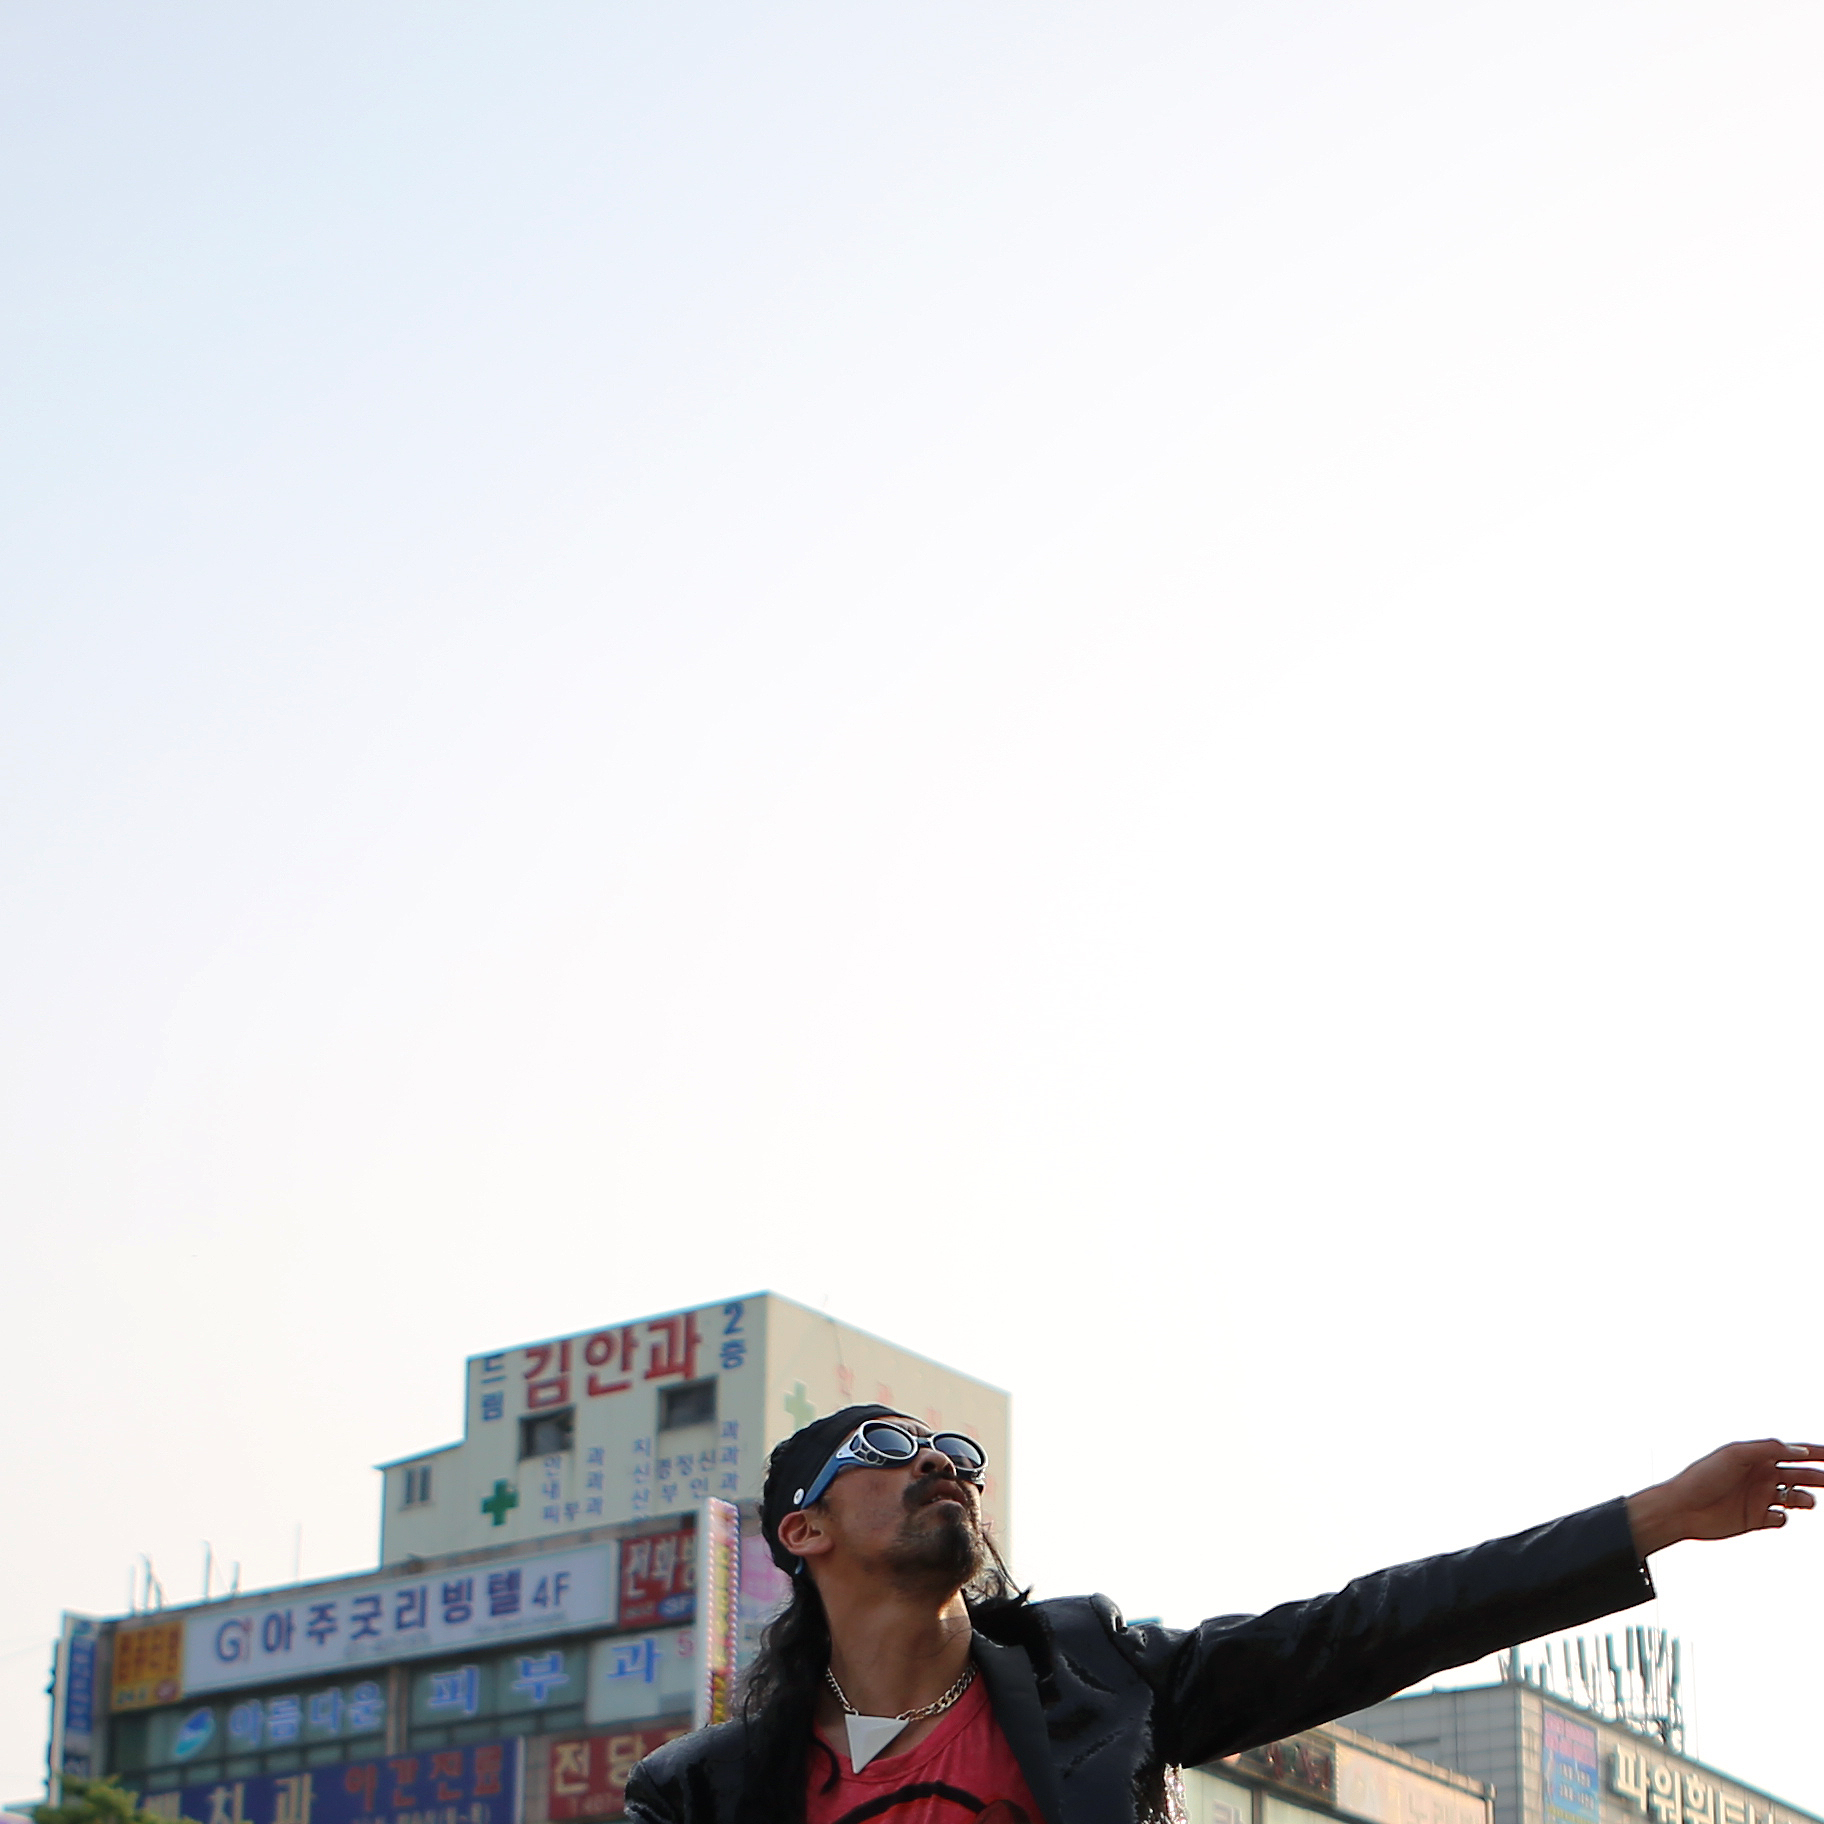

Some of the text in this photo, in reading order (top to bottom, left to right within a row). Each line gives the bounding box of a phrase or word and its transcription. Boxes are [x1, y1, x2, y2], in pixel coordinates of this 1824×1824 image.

[524, 1310, 703, 1409] 김안과
[261, 1567, 523, 1653] 아주굿리빙텔
[531, 1571, 572, 1609] 4F
[426, 1637, 664, 1716] 피부과
